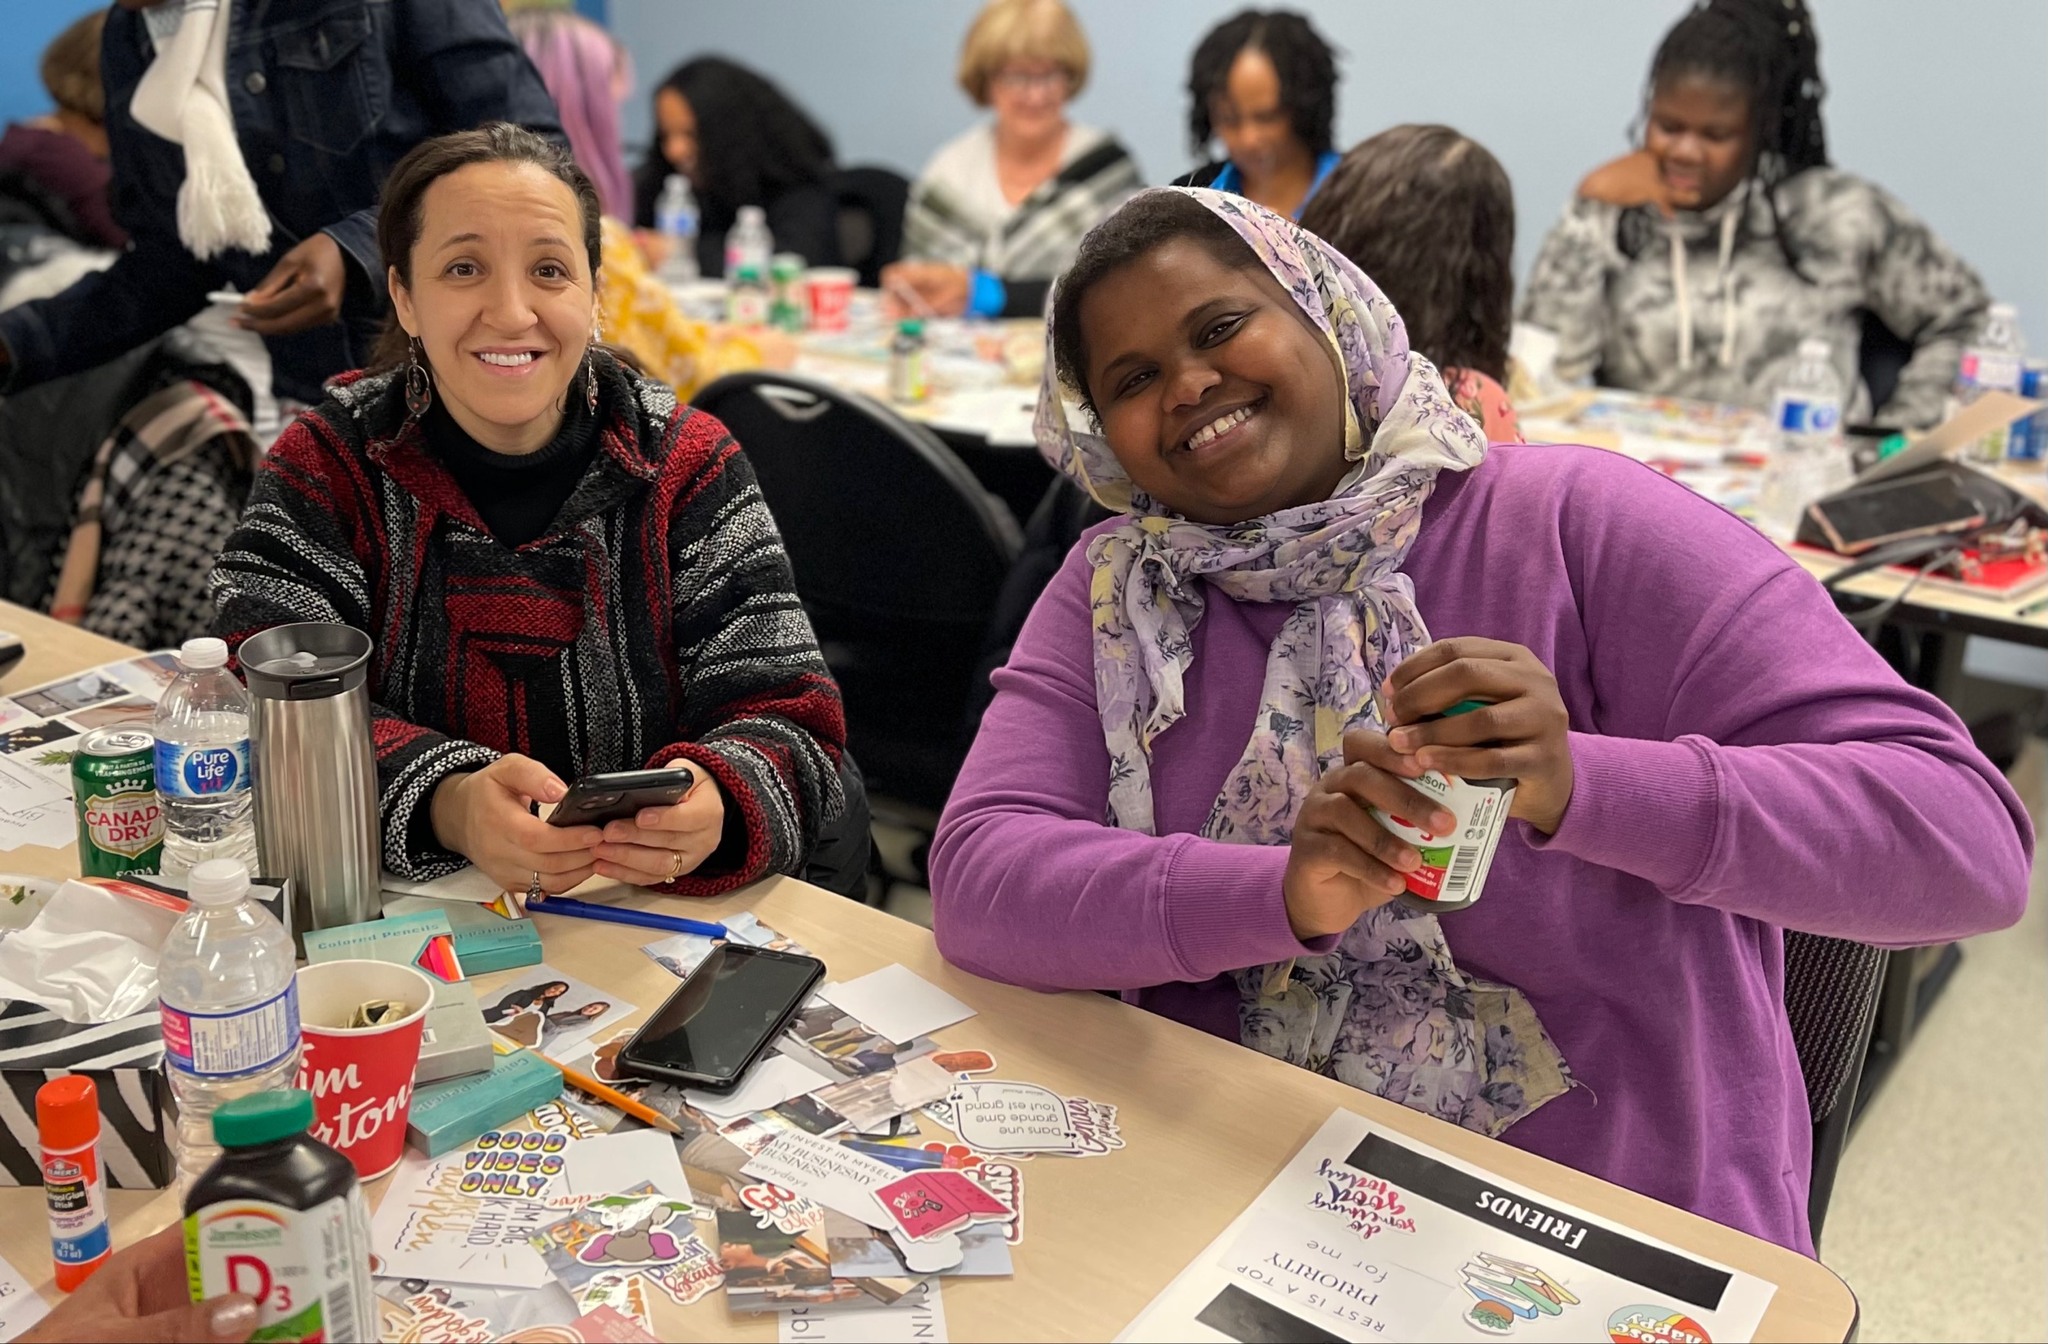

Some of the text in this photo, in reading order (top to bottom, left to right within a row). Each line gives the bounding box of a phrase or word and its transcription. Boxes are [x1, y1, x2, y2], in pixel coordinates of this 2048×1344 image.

[192, 751, 229, 765] Pure
[197, 764, 225, 780] Life
[1418, 775, 1446, 792] eson
[86, 806, 161, 827] CANAD
[108, 824, 152, 843] DRY
[317, 922, 441, 951] Colored Pencils
[308, 1064, 417, 1149] rtons
[965, 1099, 1056, 1112] tout est grand
[1010, 1112, 1059, 1124] grande
[477, 1131, 567, 1152] GOOD
[999, 1126, 1061, 1137] Dans une
[790, 1133, 834, 1153] INVEST
[835, 1151, 849, 1160] IN
[465, 1151, 564, 1175] VIBES
[459, 1172, 548, 1198] ONLY
[1314, 1158, 1387, 1195] today
[1328, 1180, 1406, 1215] good
[1346, 1220, 1381, 1239] do
[1475, 1191, 1588, 1250] FRIENDS
[1306, 1240, 1389, 1284] for me
[1263, 1251, 1379, 1307] PRIORITY
[1236, 1265, 1386, 1333] REST IS A TOP
